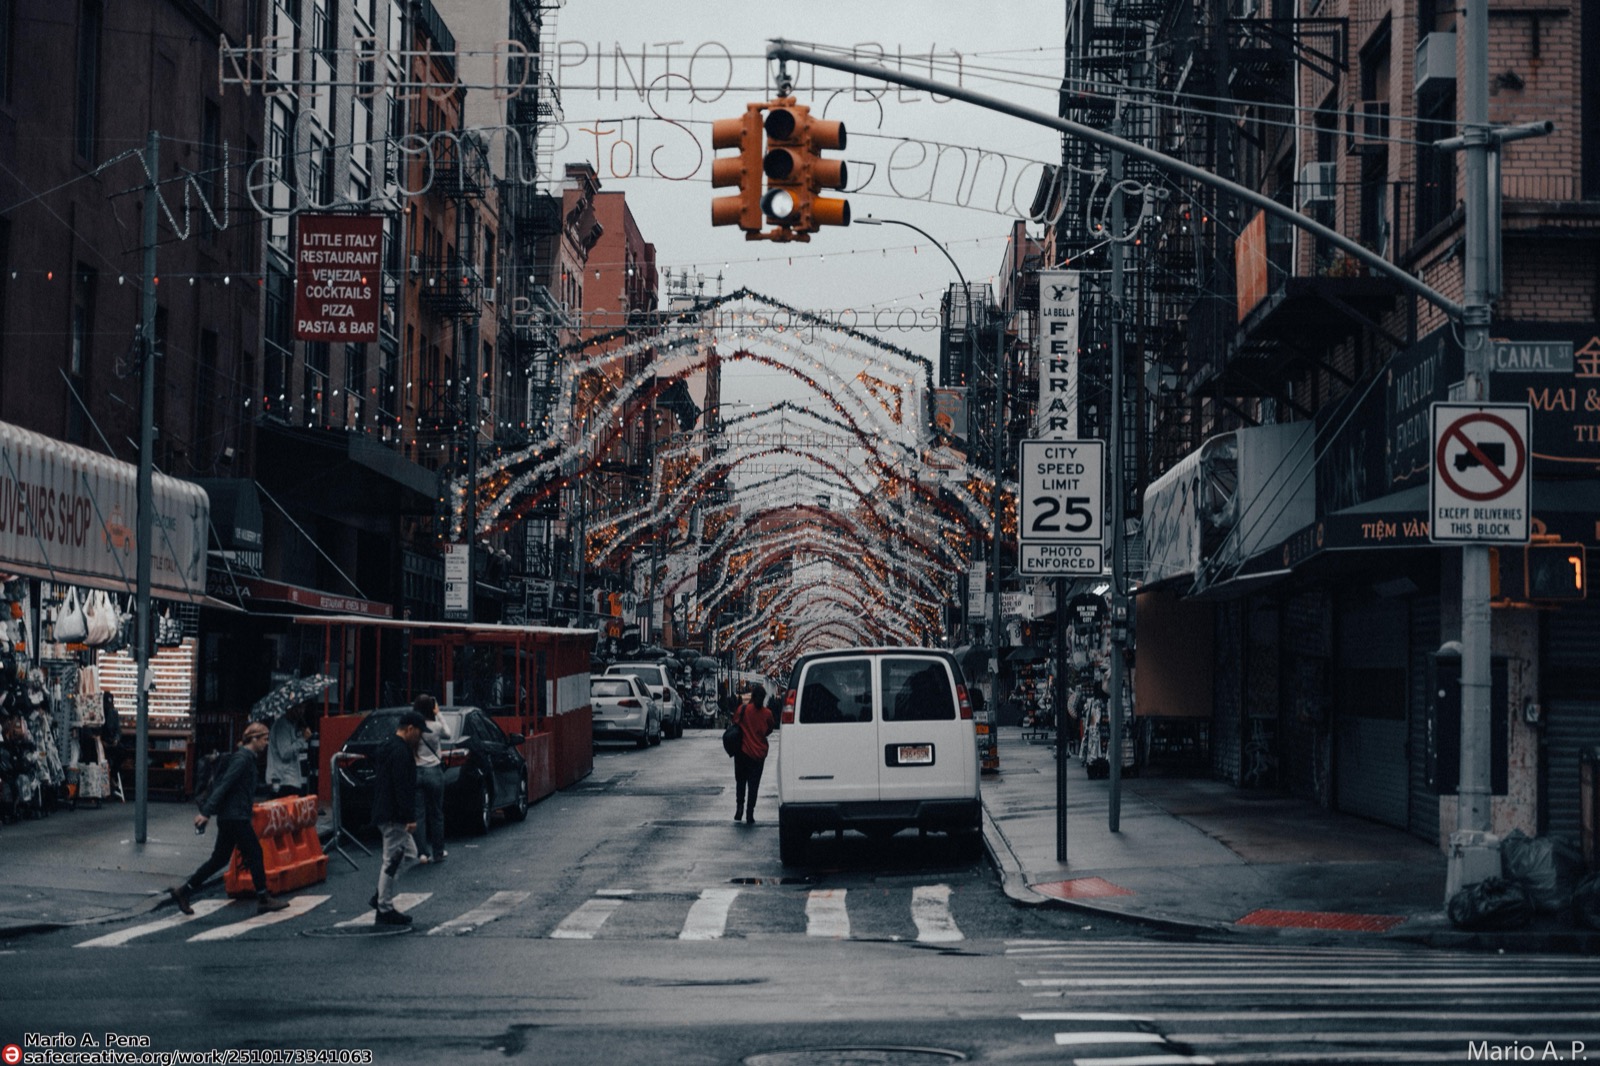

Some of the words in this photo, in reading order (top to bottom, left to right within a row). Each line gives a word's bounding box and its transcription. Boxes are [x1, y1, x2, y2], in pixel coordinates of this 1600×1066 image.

[494, 40, 733, 104] DIPINTO
[303, 233, 342, 246] LITTLE
[345, 234, 377, 247] ITALY
[300, 250, 378, 264] RESTAURANT
[312, 269, 361, 282] VENEZIA
[306, 286, 371, 299] COCKTAILS
[321, 304, 355, 317] PIZZA
[1043, 307, 1052, 317] LA
[1053, 307, 1075, 317] BELLA
[298, 320, 335, 333] PASTA
[338, 321, 347, 333] &
[350, 322, 374, 333] BAR
[1497, 346, 1554, 369] CANAL
[1558, 347, 1569, 360] ST
[1048, 321, 1068, 440] FERRAR
[1526, 386, 1576, 412] MAI
[1584, 388, 1600, 412] &
[1573, 426, 1600, 443] TI
[1045, 448, 1078, 459] CITY
[1037, 463, 1085, 475] SPEED
[1042, 479, 1080, 491] LIMIT
[58, 491, 92, 549] SHOP
[1032, 496, 1093, 533] 25
[1438, 507, 1470, 520] EXCEPT
[1473, 507, 1522, 521] DELIVERIES
[1361, 519, 1397, 542] TIỆM
[1402, 517, 1430, 539] VÀN
[1450, 522, 1472, 535] THIS
[1477, 523, 1510, 535] BLOCK
[1040, 546, 1082, 557] PHOTO
[1027, 557, 1095, 569] ENFORCED
